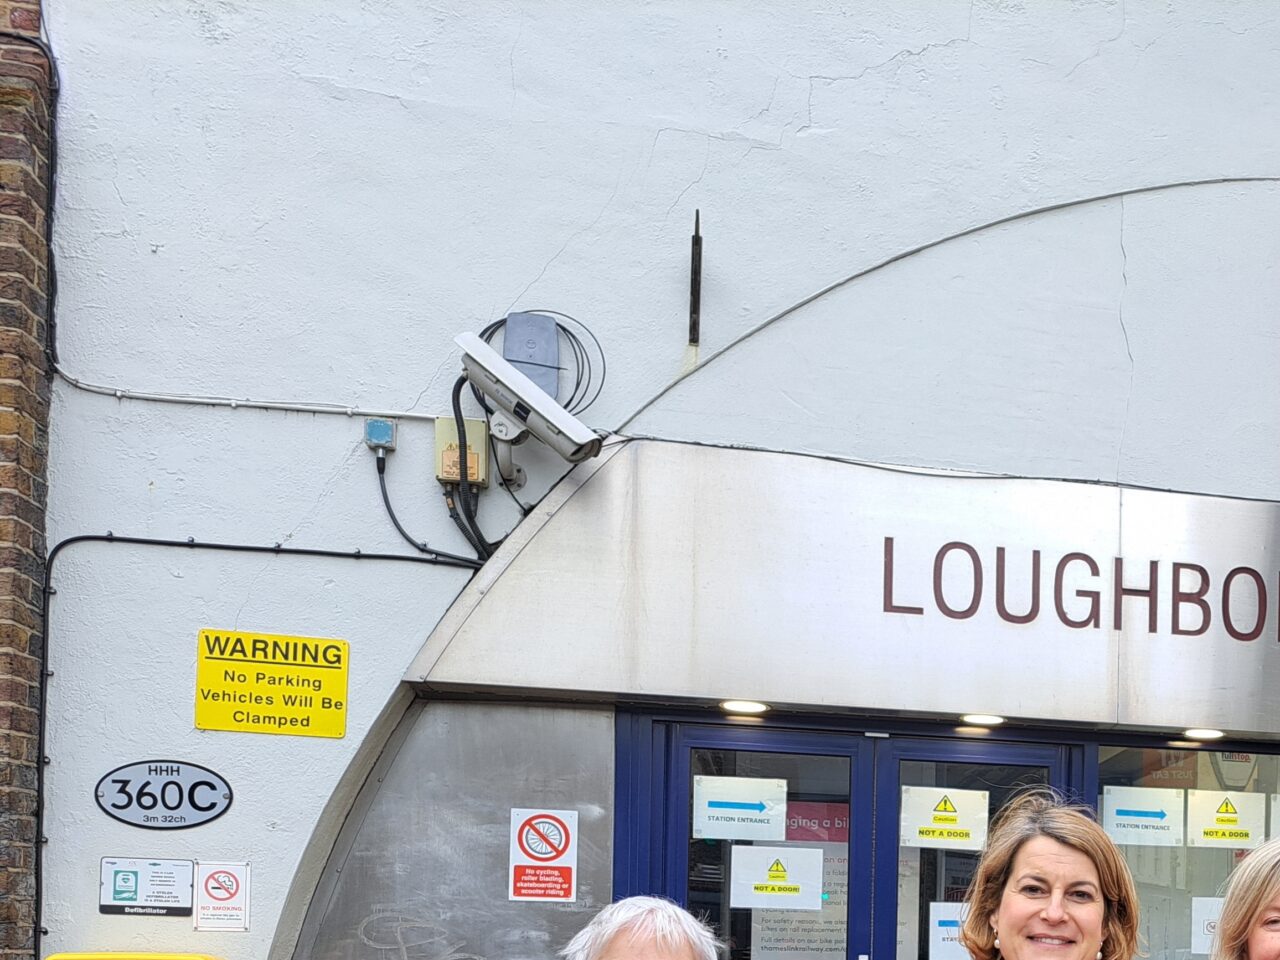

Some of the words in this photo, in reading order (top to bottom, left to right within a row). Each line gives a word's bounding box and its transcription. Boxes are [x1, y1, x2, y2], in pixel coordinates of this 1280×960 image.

[204, 634, 342, 665] WARNING
[224, 670, 247, 684] No
[255, 672, 322, 692] Parking
[200, 688, 274, 706] Vehicles
[282, 694, 313, 708] Will
[321, 697, 343, 710] Be
[233, 710, 311, 728] Clamped
[148, 765, 181, 777] HHH
[110, 779, 218, 813] 360C
[142, 815, 159, 824] 3m
[161, 815, 187, 824] 32ch
[708, 815, 736, 823] STATION
[737, 816, 771, 825] ENTRANCE
[1116, 823, 1140, 831] STATION
[1140, 824, 1171, 832] ENTRANCE
[918, 829, 937, 837] NOT
[946, 831, 971, 839] DOOR
[1203, 830, 1219, 838] NOT
[1229, 831, 1250, 839] DOOR
[536, 869, 560, 877] cycling,
[517, 882, 561, 890] skateboarding
[124, 906, 168, 915] Defibrillator
